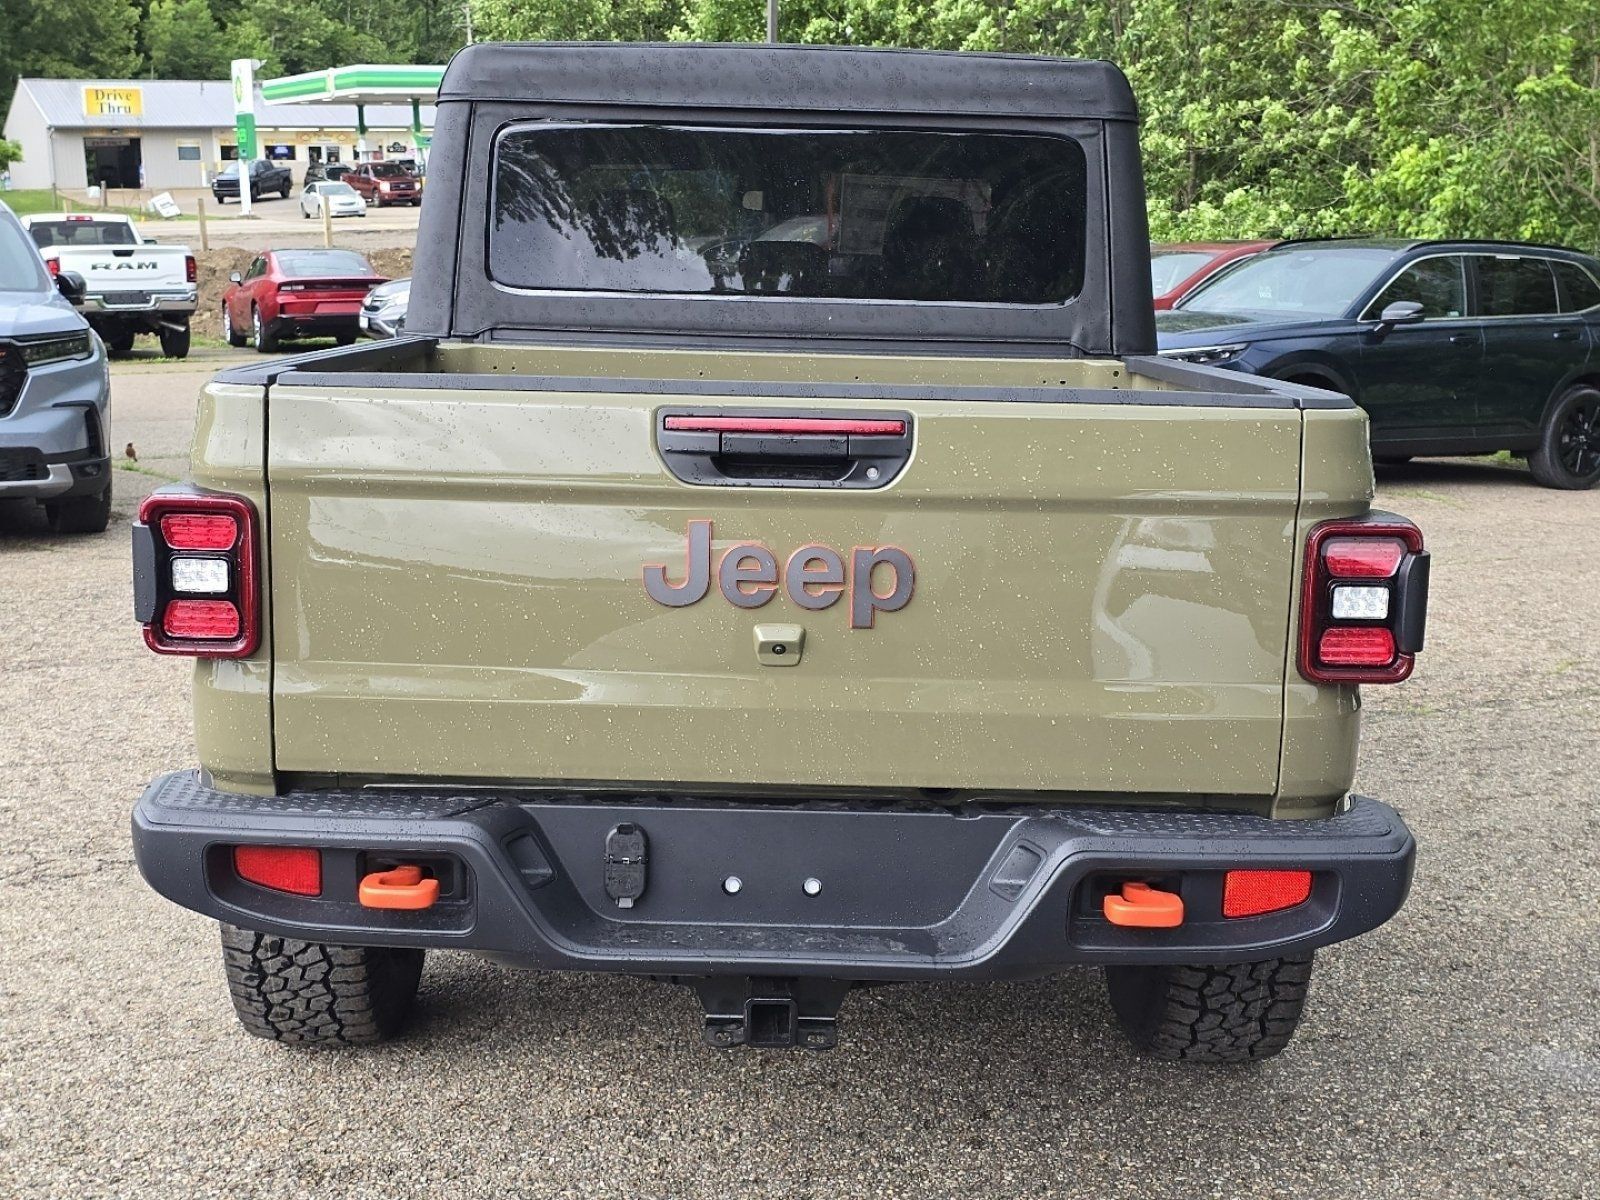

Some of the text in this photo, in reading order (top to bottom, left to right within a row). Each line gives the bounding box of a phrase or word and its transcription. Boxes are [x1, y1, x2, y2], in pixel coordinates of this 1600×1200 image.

[95, 89, 132, 101] Drive
[96, 102, 132, 113] Thru
[91, 262, 158, 271] RAM
[642, 519, 916, 630] Jeep
